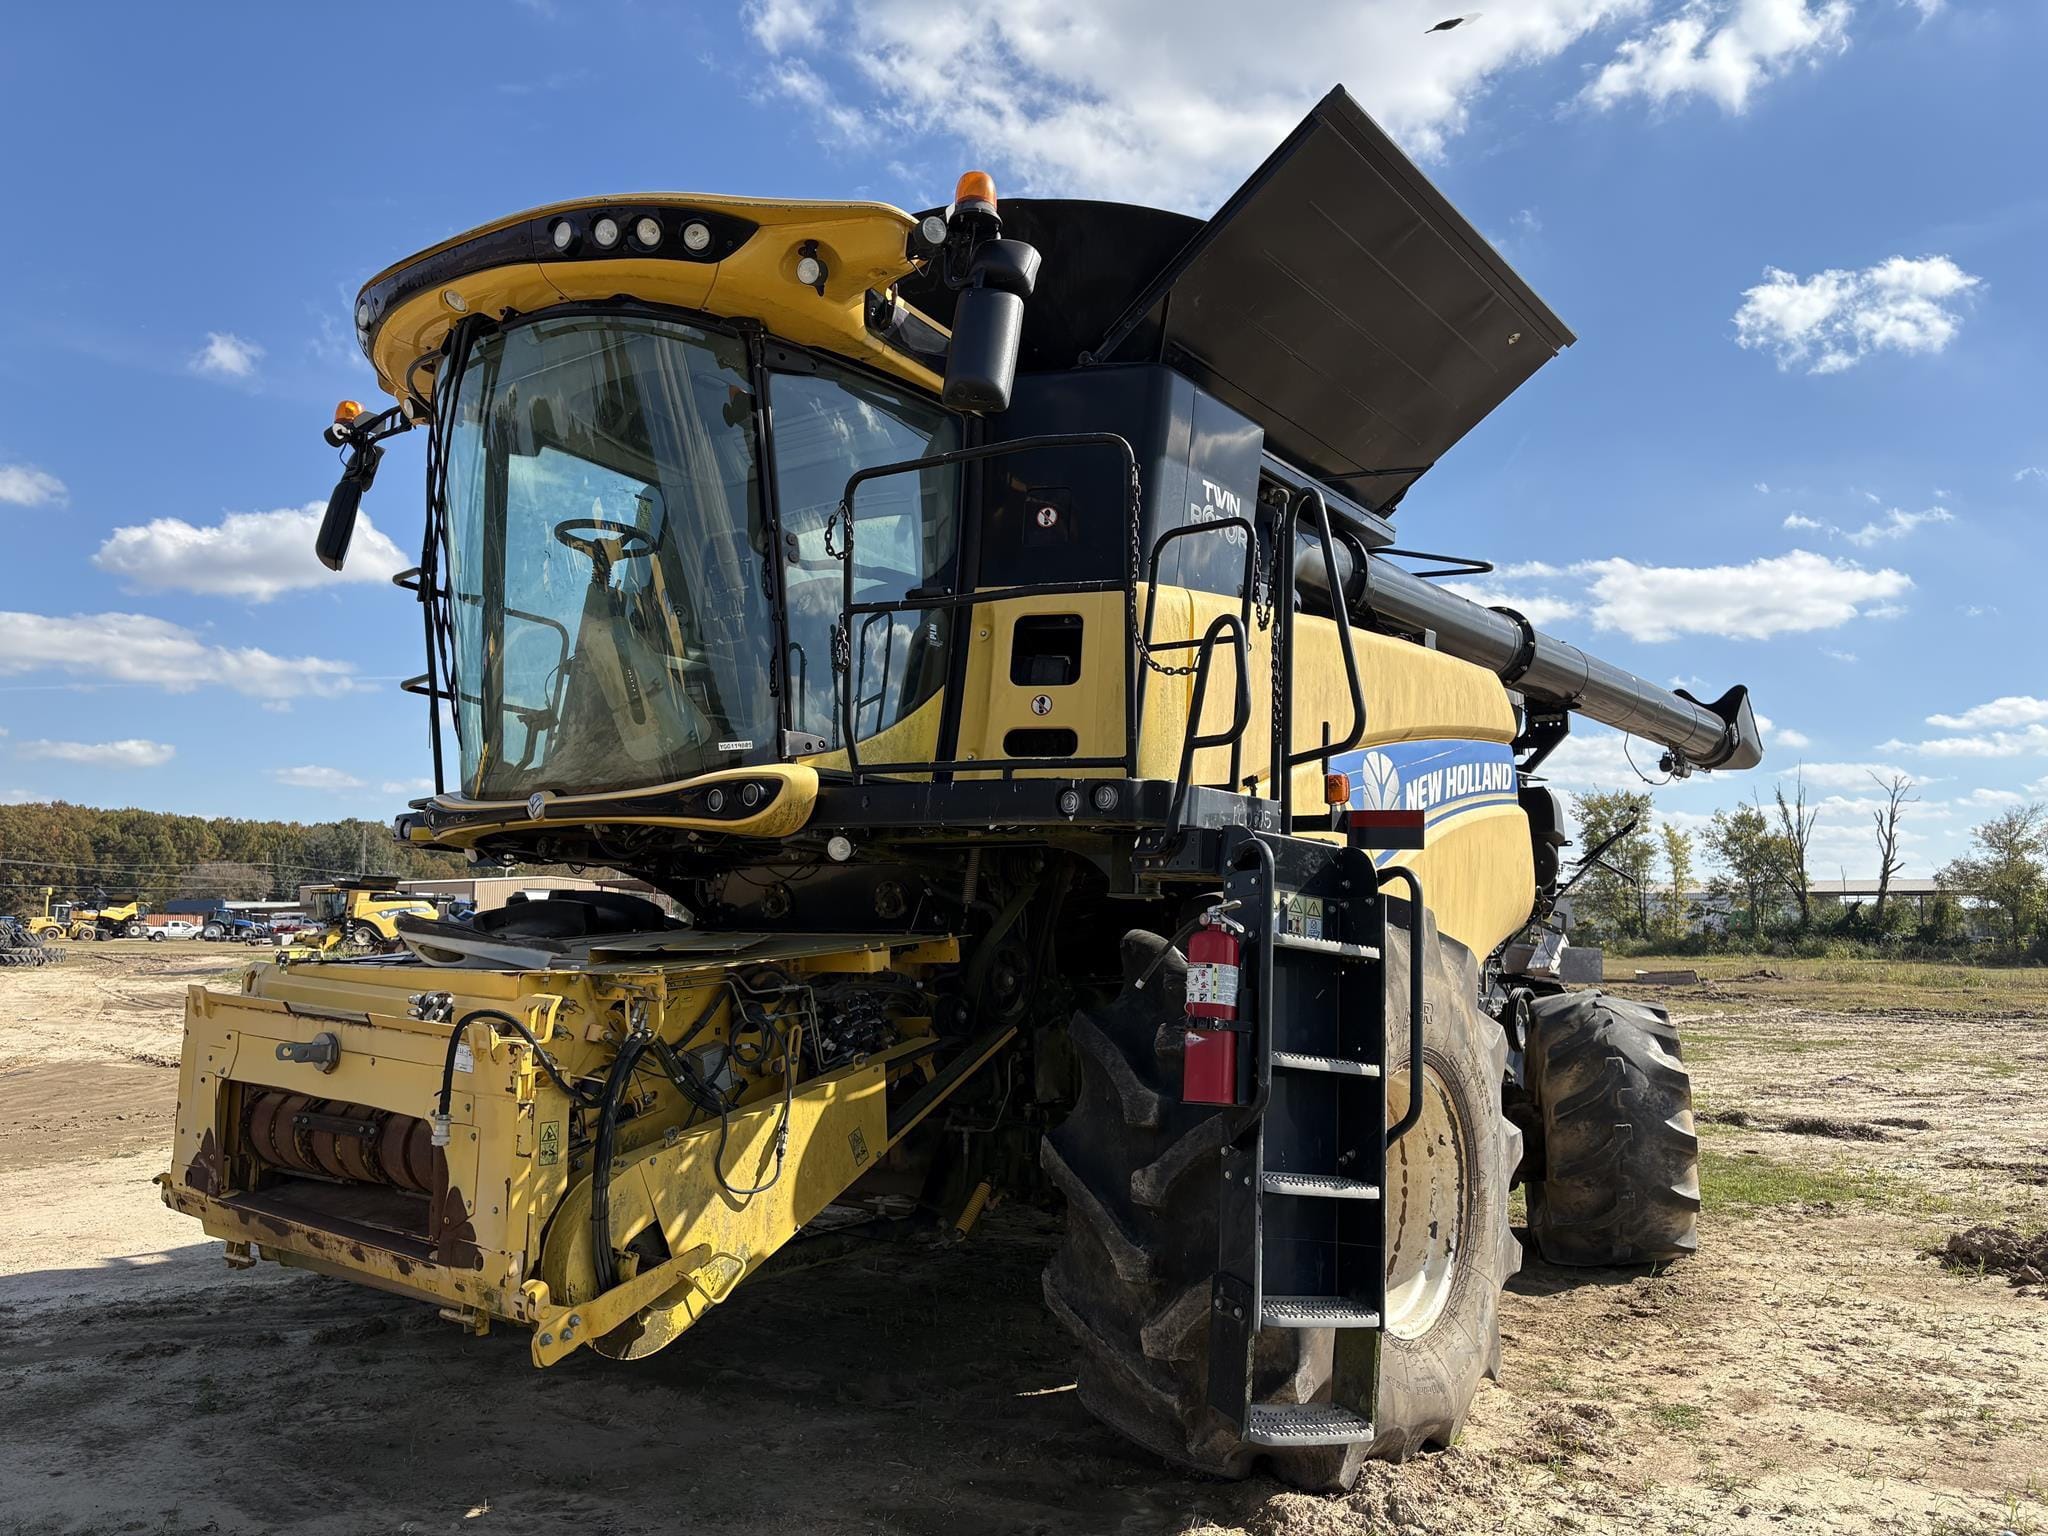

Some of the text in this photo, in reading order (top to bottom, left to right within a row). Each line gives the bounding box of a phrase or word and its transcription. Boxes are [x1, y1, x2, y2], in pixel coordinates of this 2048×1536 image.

[1203, 479, 1240, 518] TWIN
[1406, 763, 1511, 810] NEW HOLLAND
